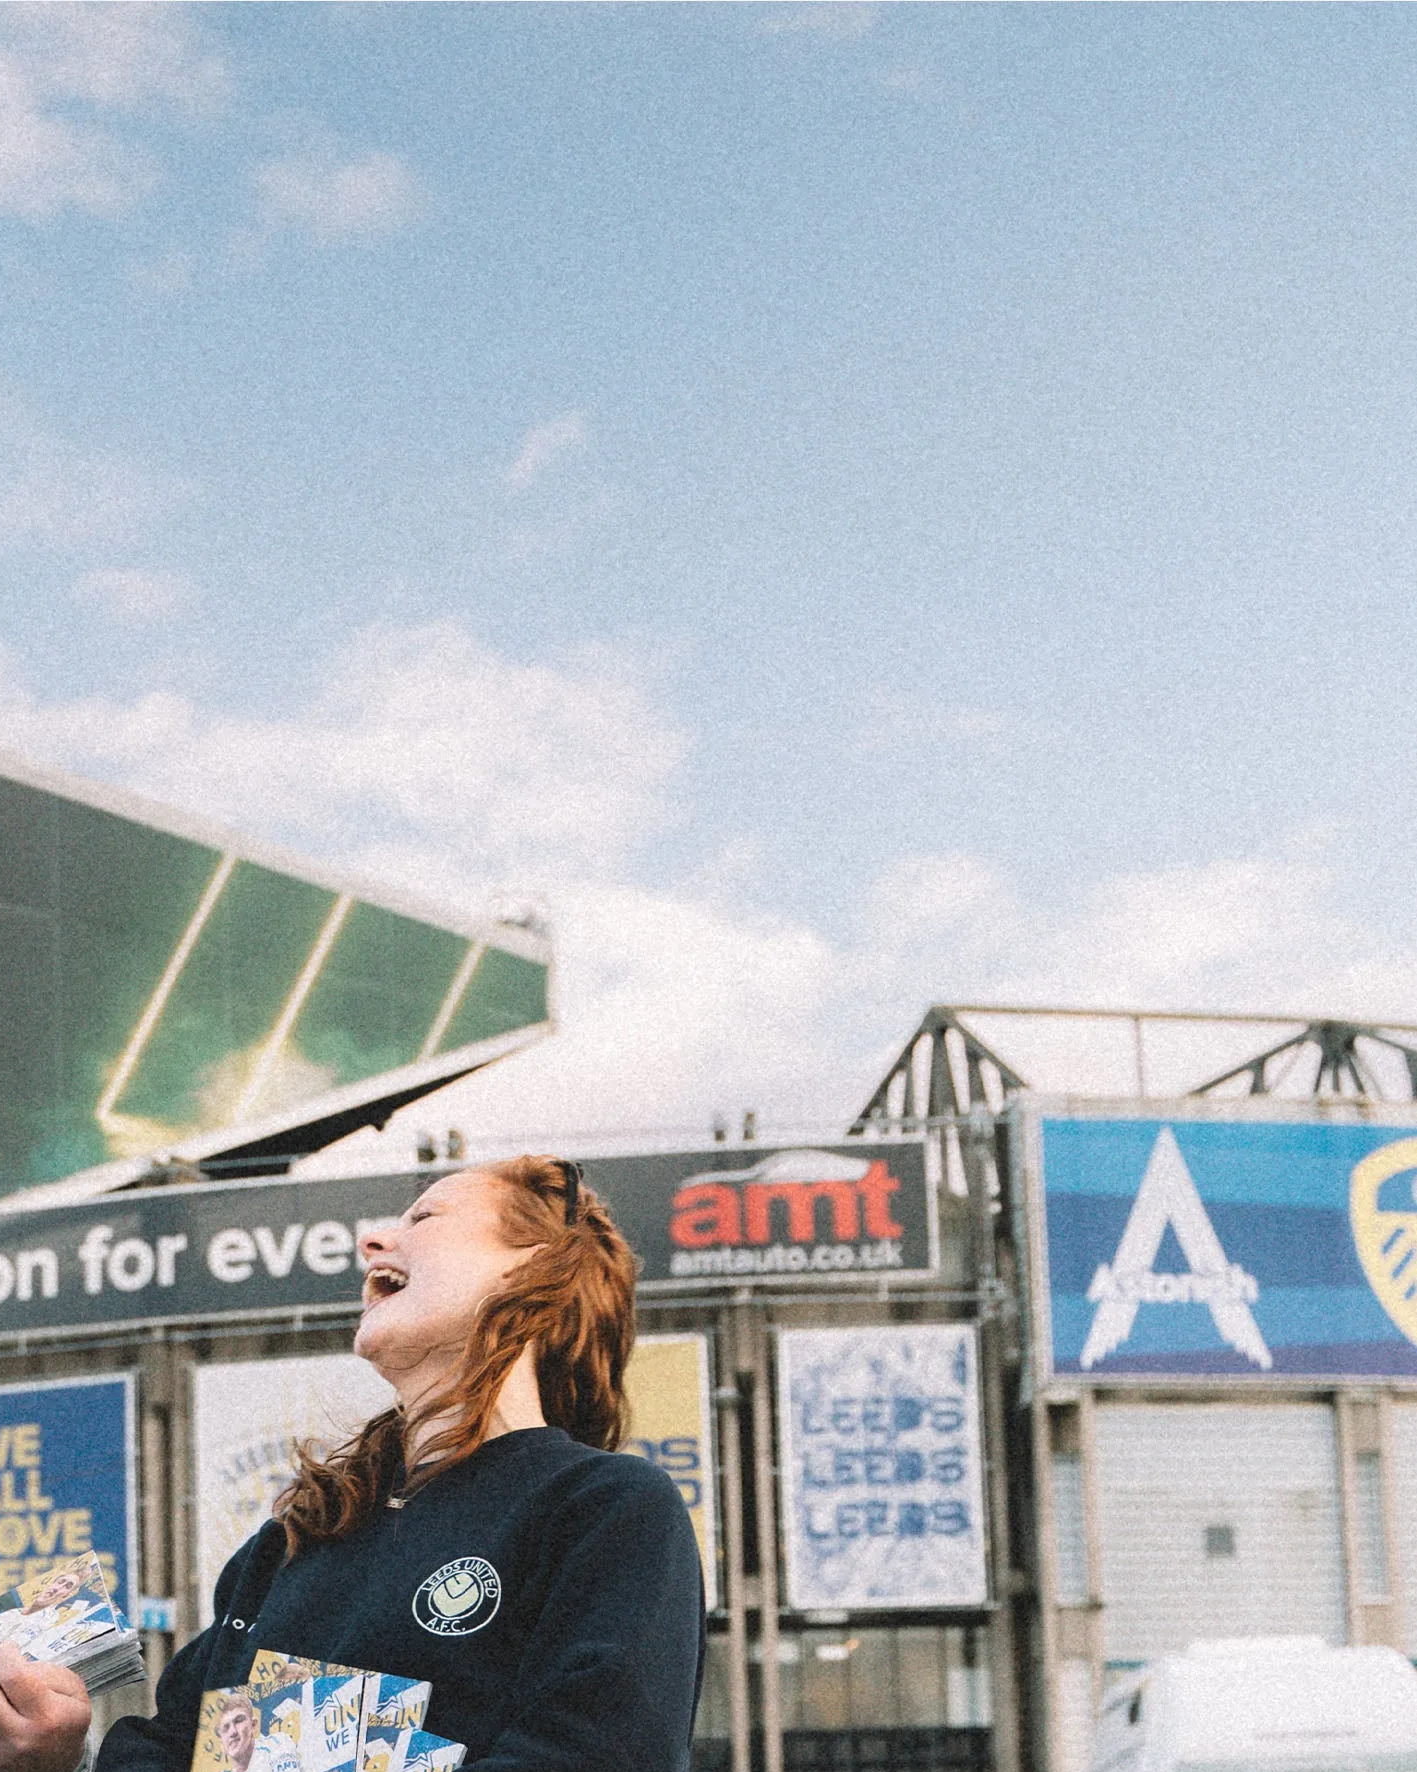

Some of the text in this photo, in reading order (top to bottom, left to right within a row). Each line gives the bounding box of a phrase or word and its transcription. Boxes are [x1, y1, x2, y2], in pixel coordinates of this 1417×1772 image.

[669, 1160, 905, 1248] amt
[80, 1225, 187, 1294] for
[670, 1240, 905, 1276] amtauto.co.uk
[422, 1559, 499, 1598] LEEDS UNITED
[425, 1616, 466, 1632] A.F.C.
[325, 1728, 351, 1752] WE
